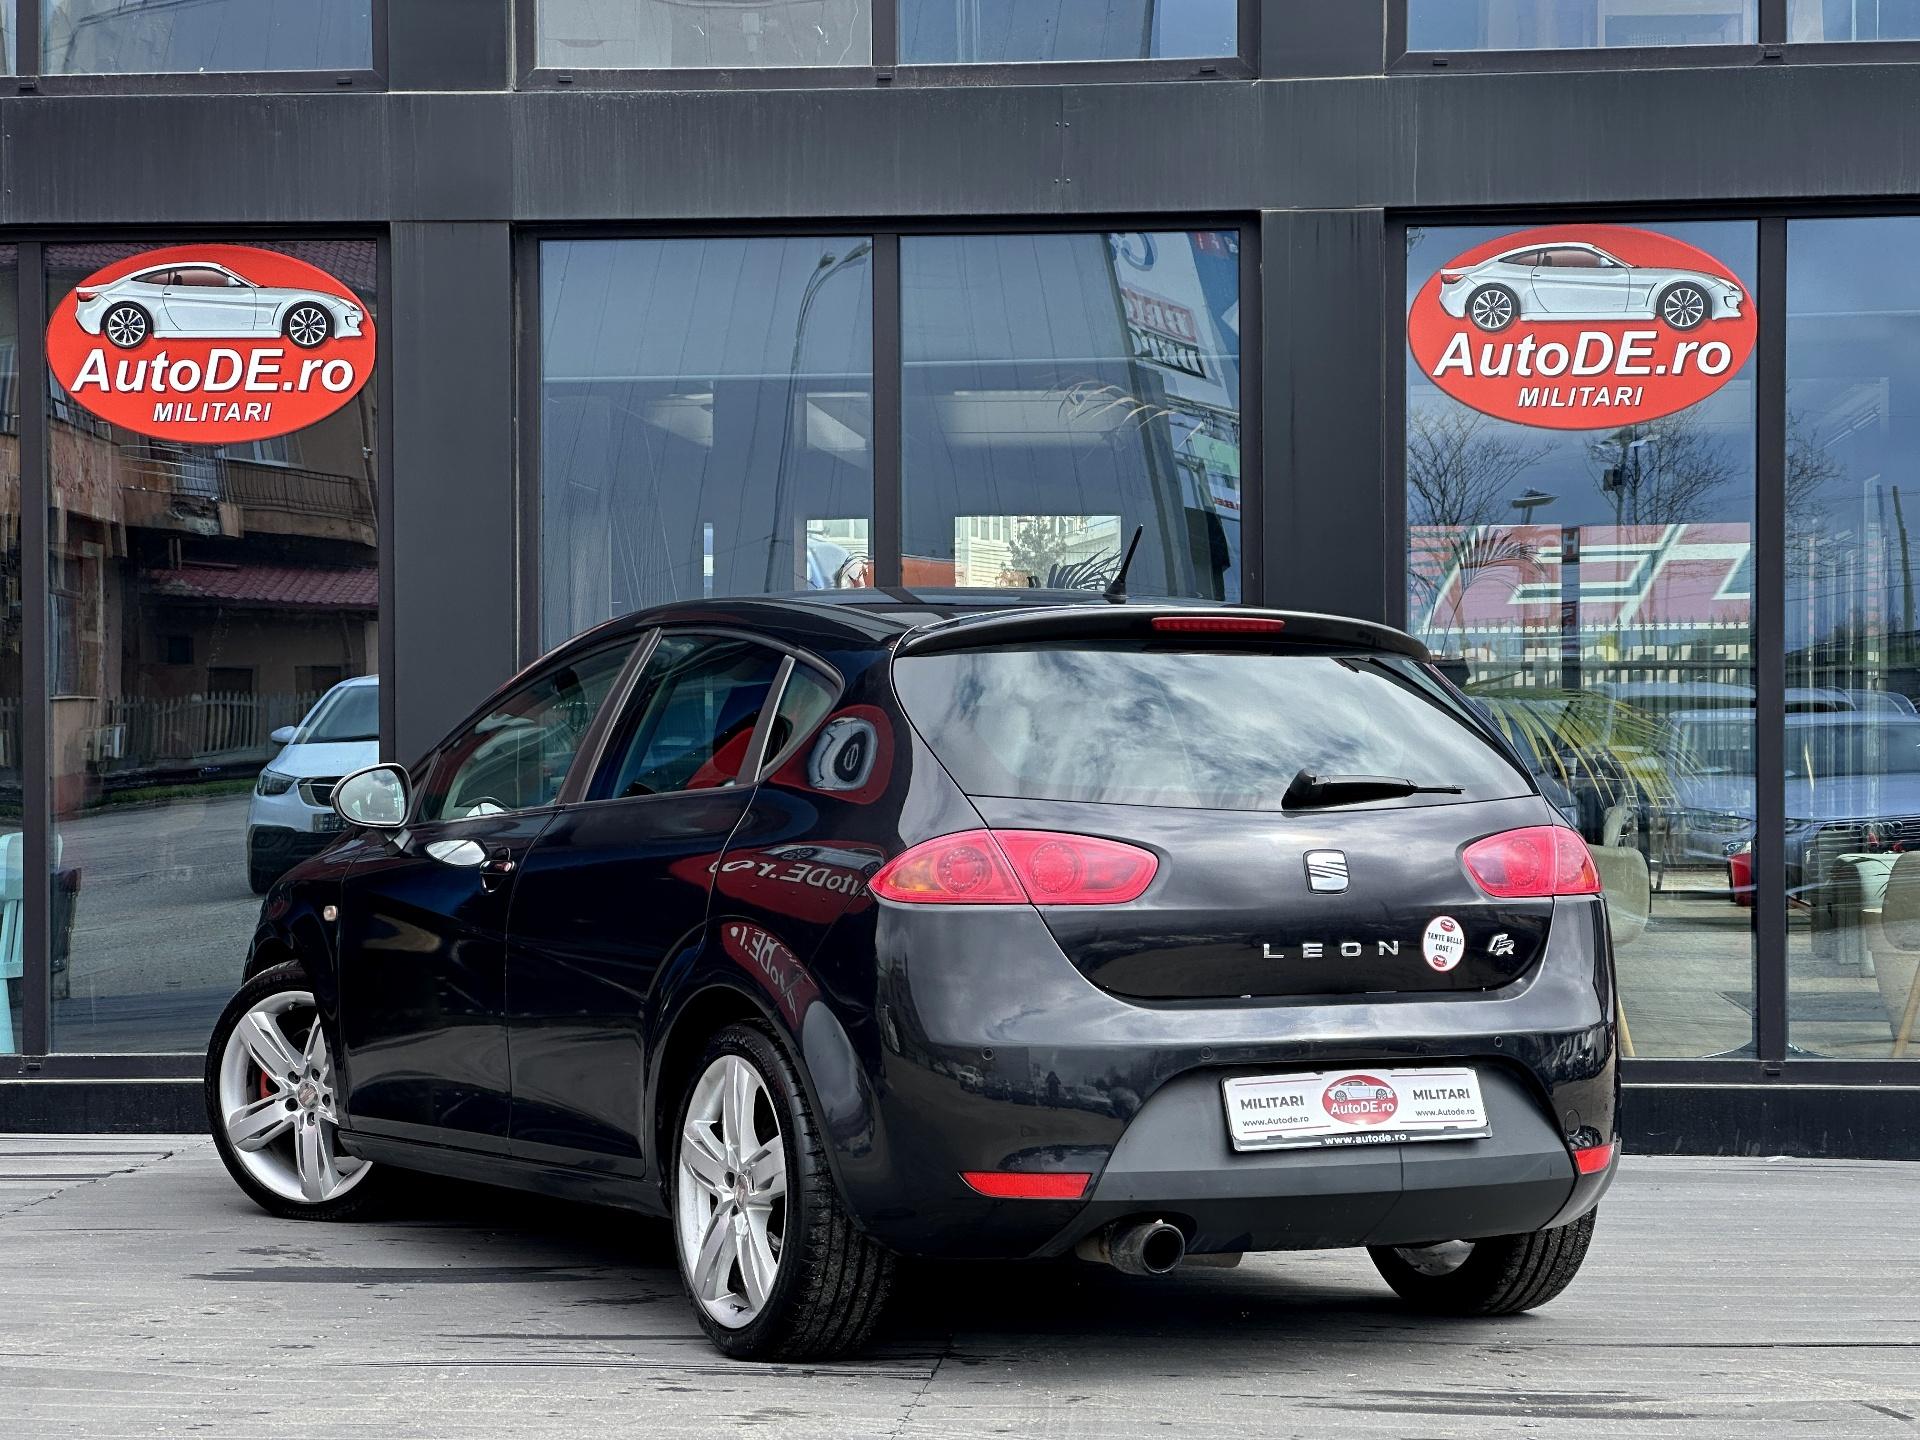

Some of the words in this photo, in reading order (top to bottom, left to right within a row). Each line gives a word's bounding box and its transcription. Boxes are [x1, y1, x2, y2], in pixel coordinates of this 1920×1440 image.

[1432, 330, 1732, 377] AutoDE.ro
[70, 347, 355, 393] AutoDE.ro
[1517, 386, 1644, 407] MILITARI
[152, 402, 272, 422] MILITARI
[1263, 941, 1399, 959] LEON
[1412, 1088, 1471, 1101] MILITARI
[1240, 1095, 1305, 1110] MILITARI
[1330, 1100, 1395, 1115] AutoDE.ro
[1415, 1107, 1475, 1117] www.Autode.ro
[1242, 1115, 1310, 1127] www.Autode.ro
[1324, 1132, 1407, 1145] www.autode.ro
